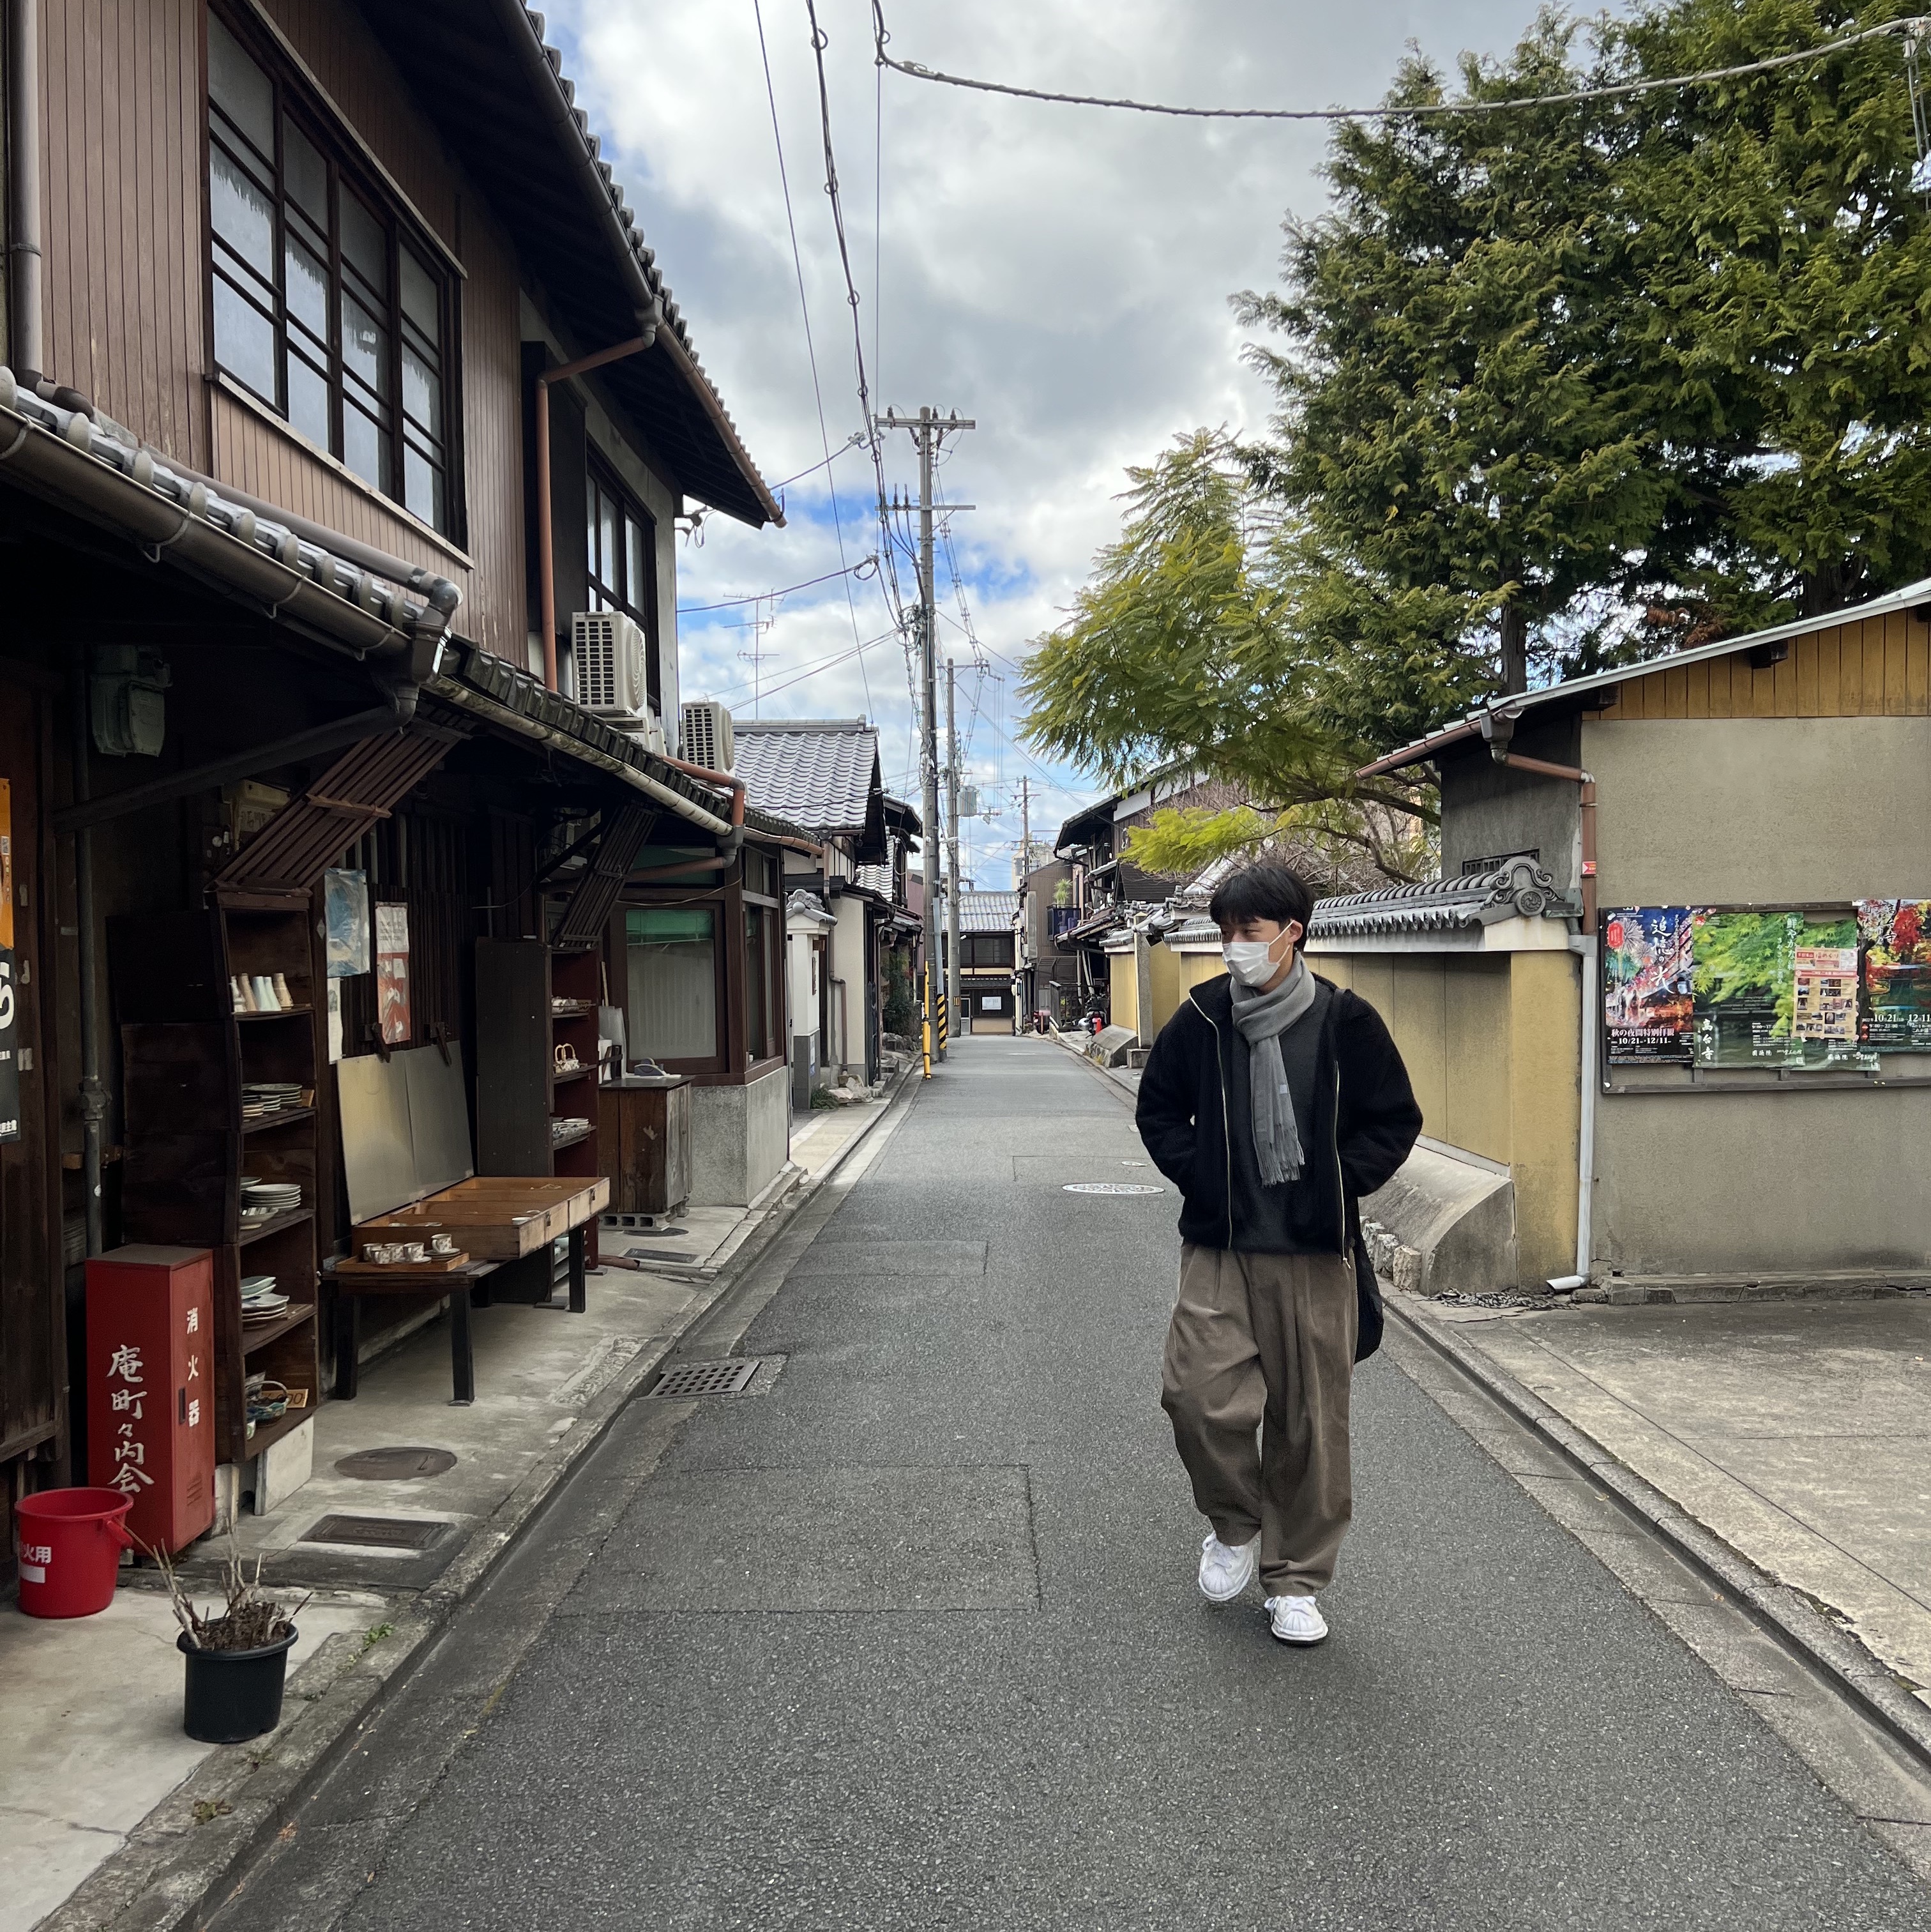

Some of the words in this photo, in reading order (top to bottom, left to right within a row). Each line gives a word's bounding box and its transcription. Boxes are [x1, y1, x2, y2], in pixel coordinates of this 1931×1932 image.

[1650, 915, 1676, 994] 追憶の光
[1701, 1018, 1714, 1060] 高台寺
[186, 1307, 200, 1427] 消火器
[107, 1344, 155, 1493] 庵町々内会
[20, 1542, 52, 1564] 火用
